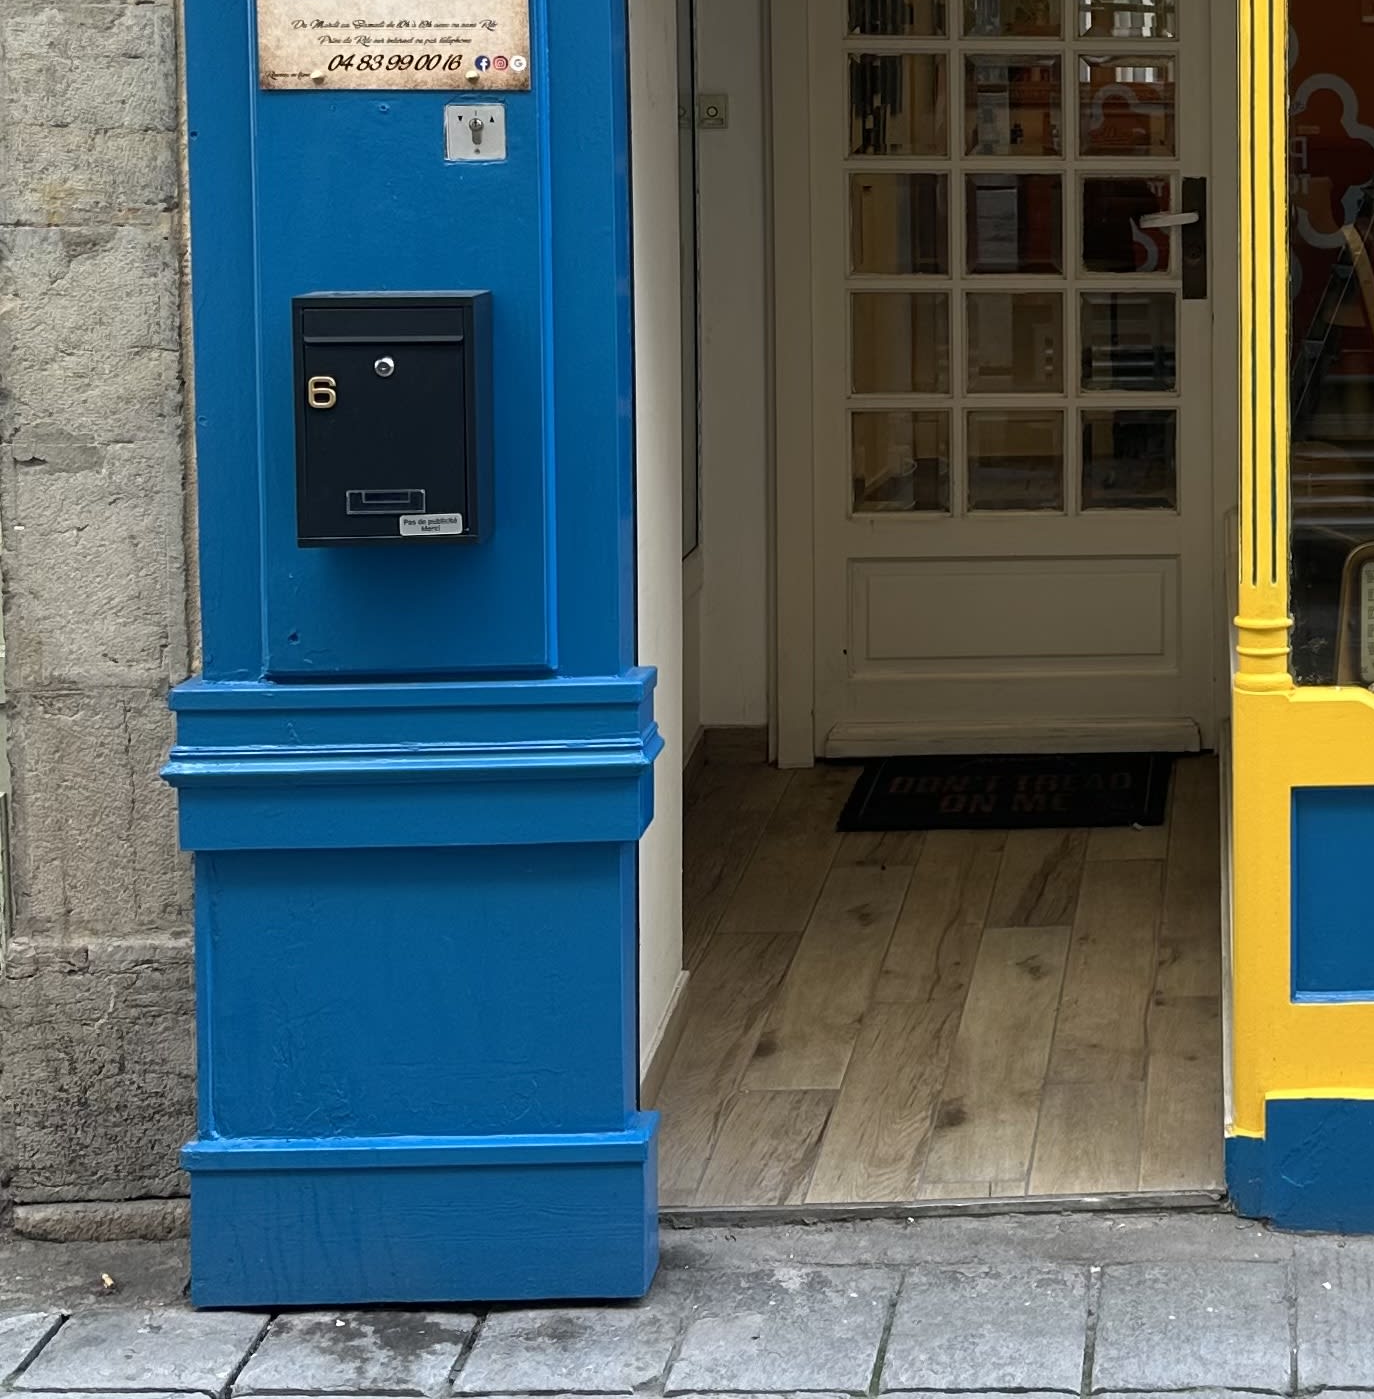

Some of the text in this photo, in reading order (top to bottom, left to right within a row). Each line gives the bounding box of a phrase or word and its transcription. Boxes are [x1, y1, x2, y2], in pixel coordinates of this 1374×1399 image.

[327, 53, 463, 71] 04 83 99 00 16
[307, 376, 337, 409] 6
[403, 518, 416, 526] Pas
[427, 517, 457, 526] publicité
